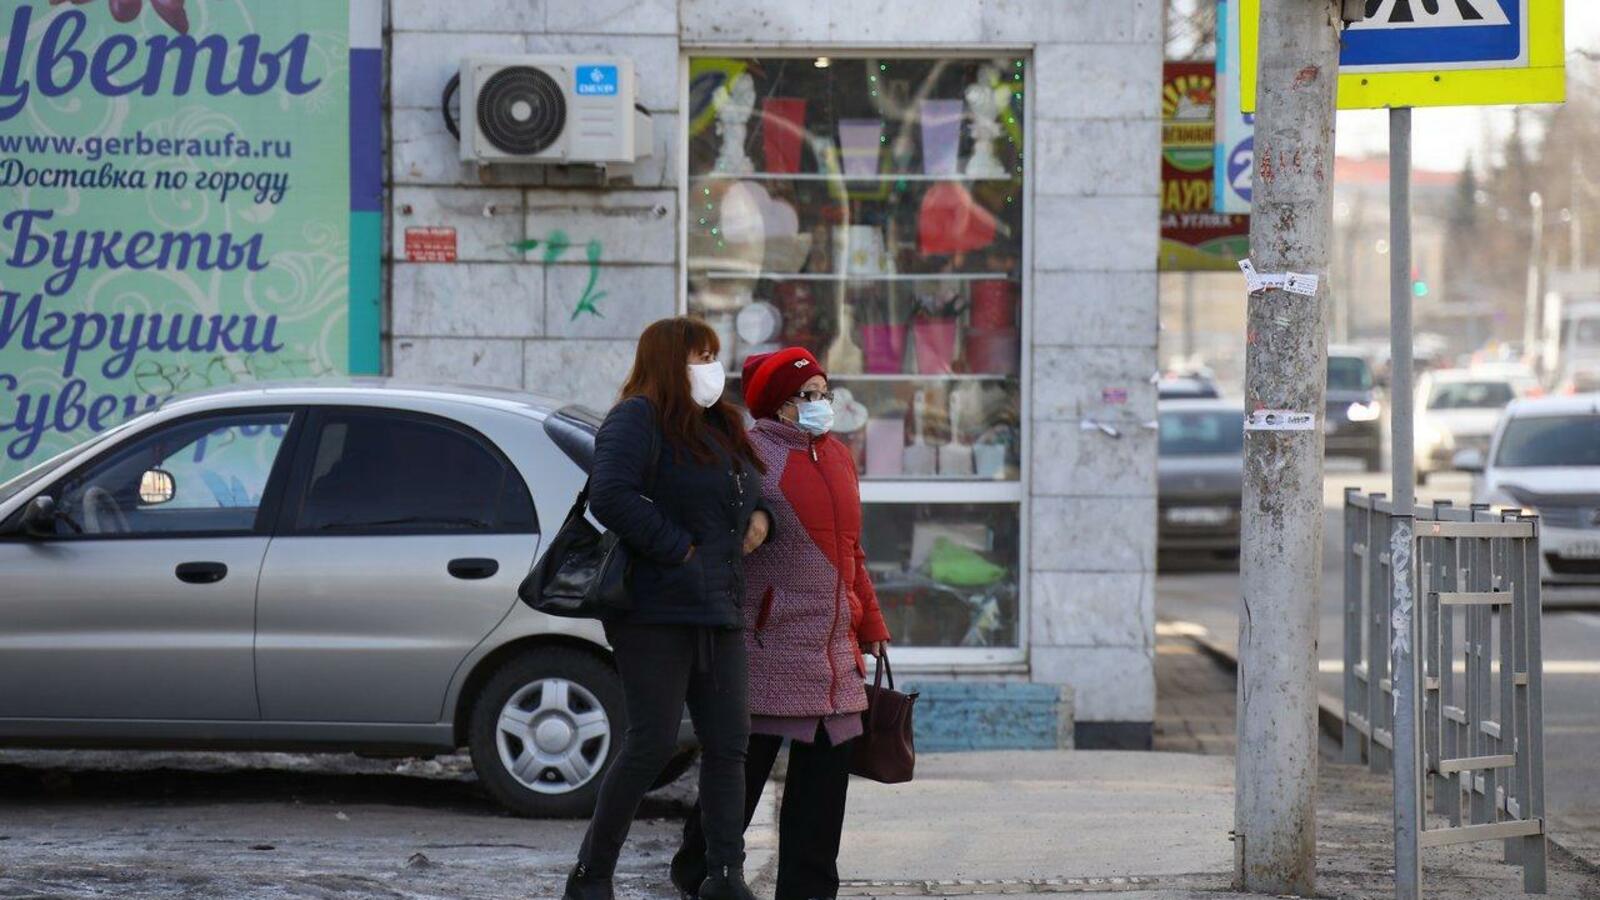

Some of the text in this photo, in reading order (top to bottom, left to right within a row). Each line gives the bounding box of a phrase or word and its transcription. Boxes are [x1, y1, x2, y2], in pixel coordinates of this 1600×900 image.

[0, 131, 292, 161] www.gerberaufa.ru
[0, 158, 289, 204] Доставка по городу
[3, 209, 269, 296] Букеты
[0, 290, 284, 379] Игрушки
